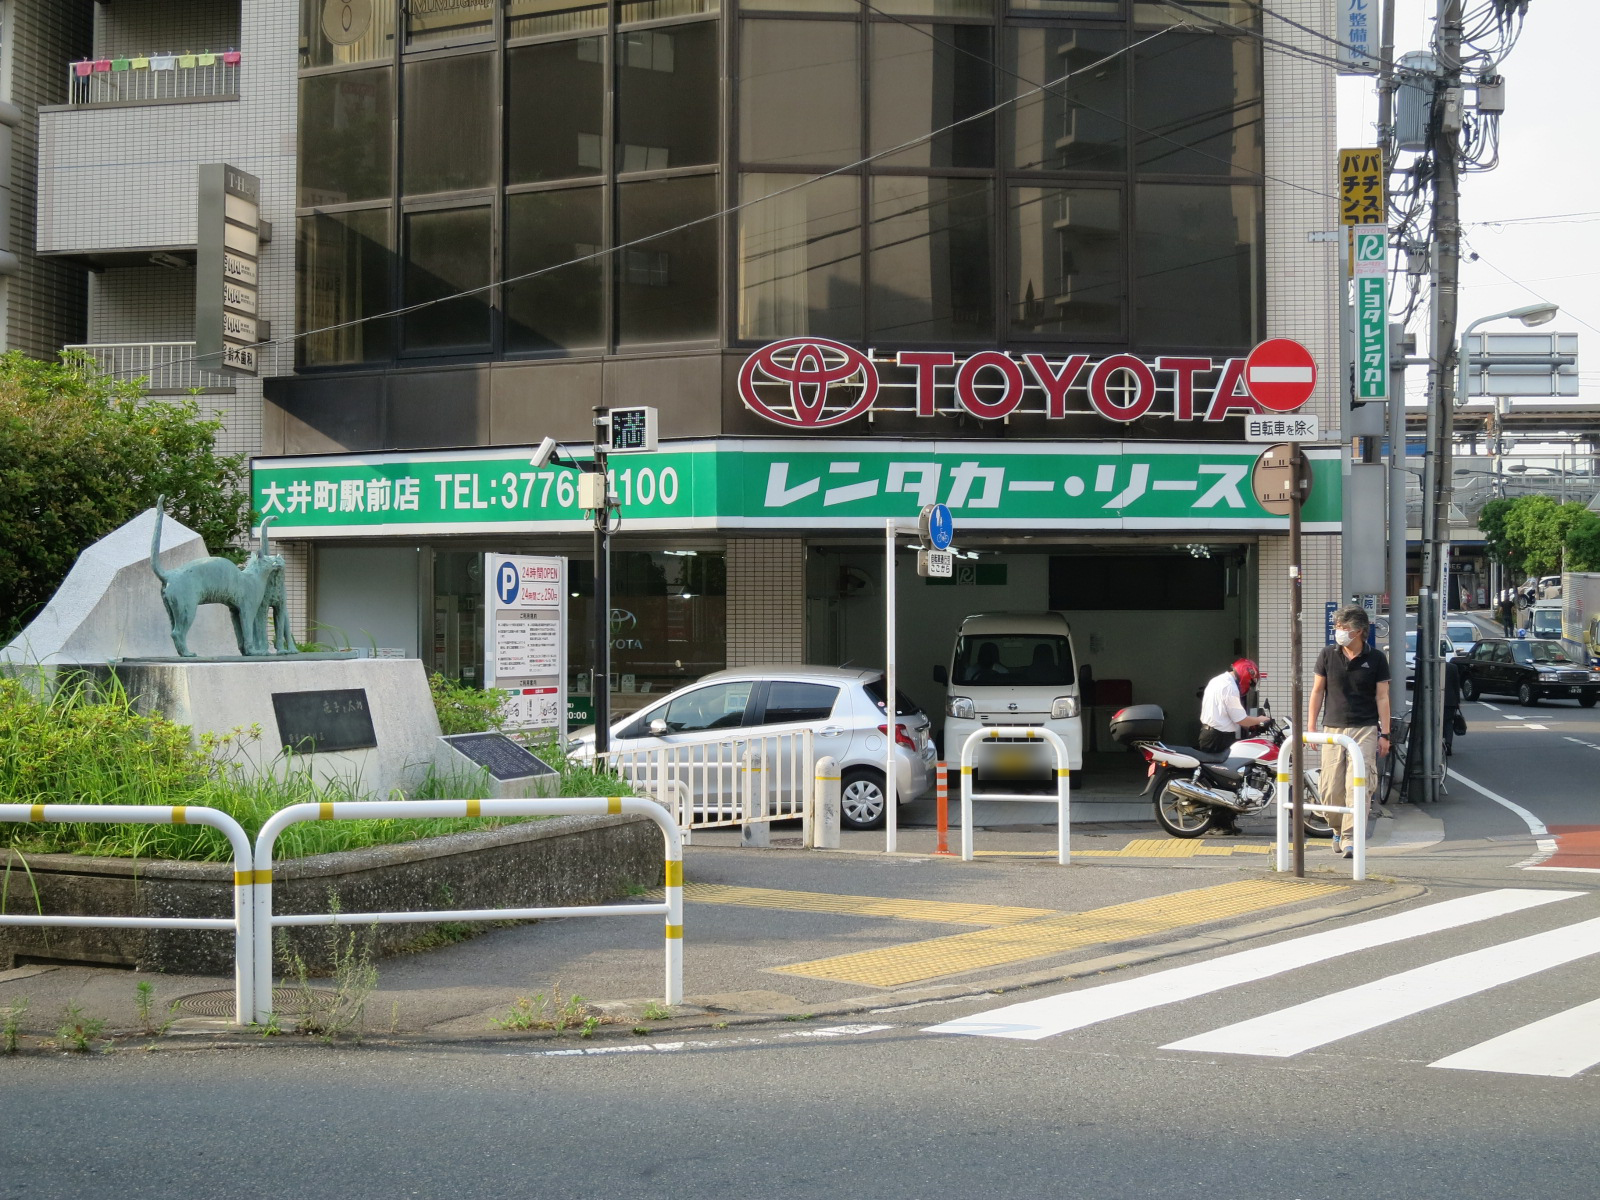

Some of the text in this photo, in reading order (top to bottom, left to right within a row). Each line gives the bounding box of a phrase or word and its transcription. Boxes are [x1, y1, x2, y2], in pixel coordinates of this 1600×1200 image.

[1363, 279, 1382, 395] トヨタレンタカー
[897, 351, 1264, 423] TOYOTA
[613, 411, 647, 449] 満
[1250, 421, 1315, 436] 自転車を除く
[260, 477, 420, 514] 大井町駅前店
[764, 461, 1248, 509] レンタカー・リース
[521, 567, 558, 579] 24時間OPEN
[567, 711, 587, 719] 0:00
